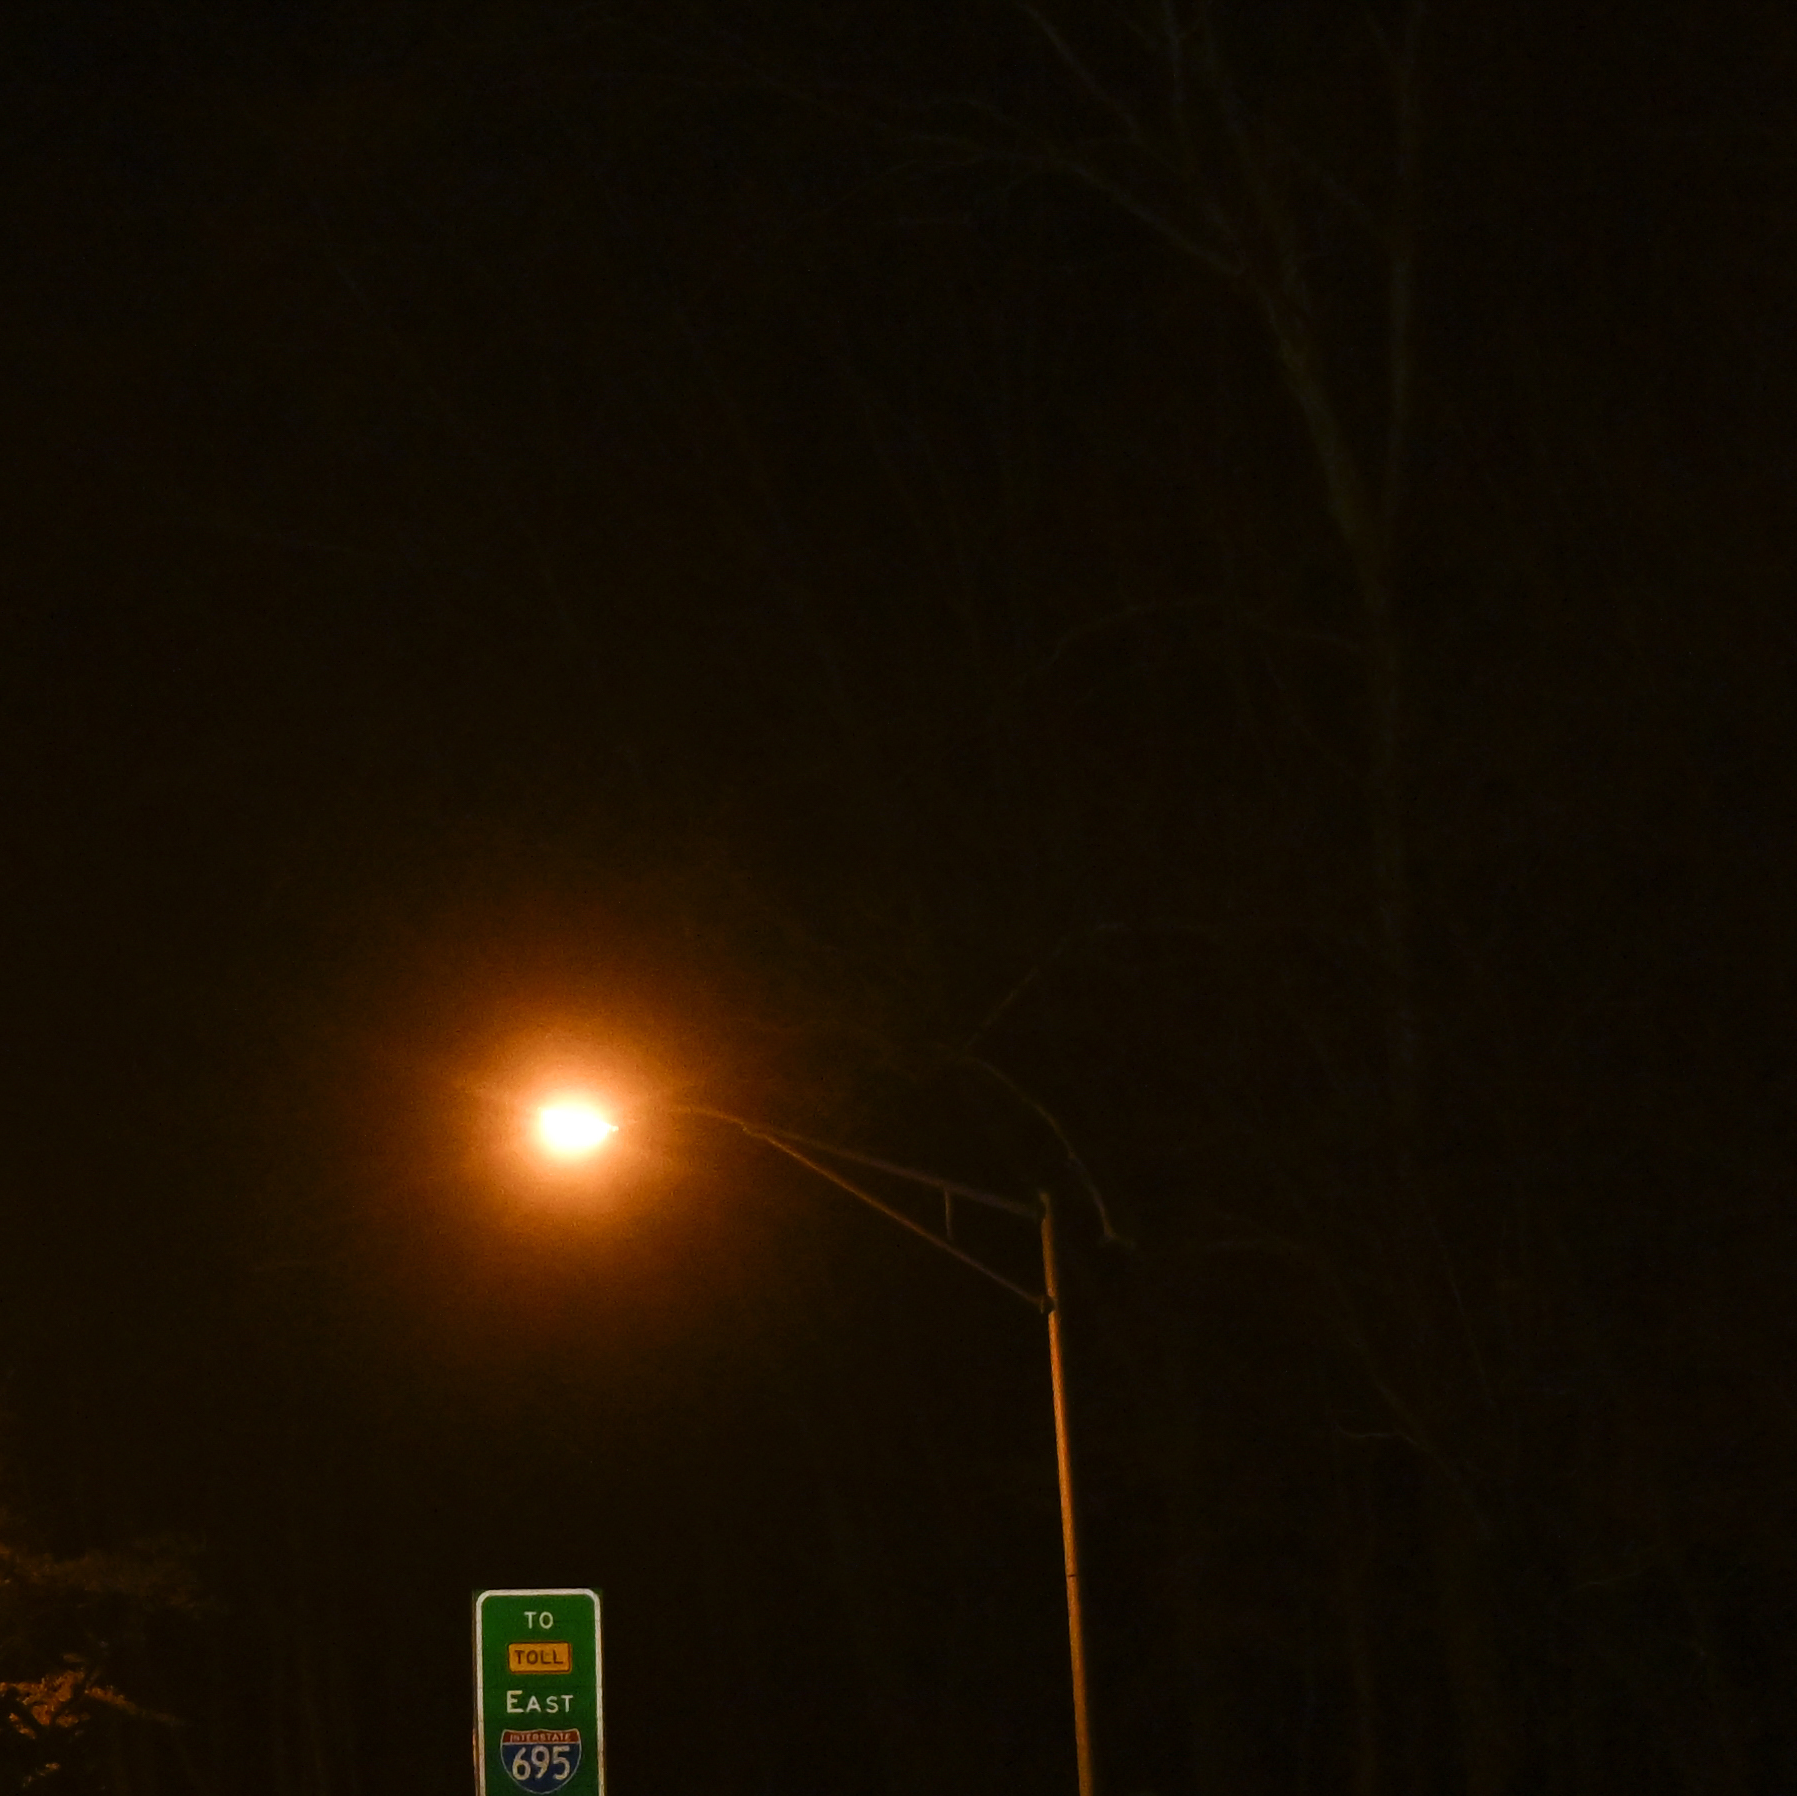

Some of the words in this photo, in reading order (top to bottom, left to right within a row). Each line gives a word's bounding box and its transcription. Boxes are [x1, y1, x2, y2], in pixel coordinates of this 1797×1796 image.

[523, 1610, 555, 1630] TO
[514, 1649, 565, 1666] TOLL
[506, 1690, 574, 1714] EAST
[509, 1732, 572, 1743] INTERSTATE
[511, 1745, 571, 1781] 695
